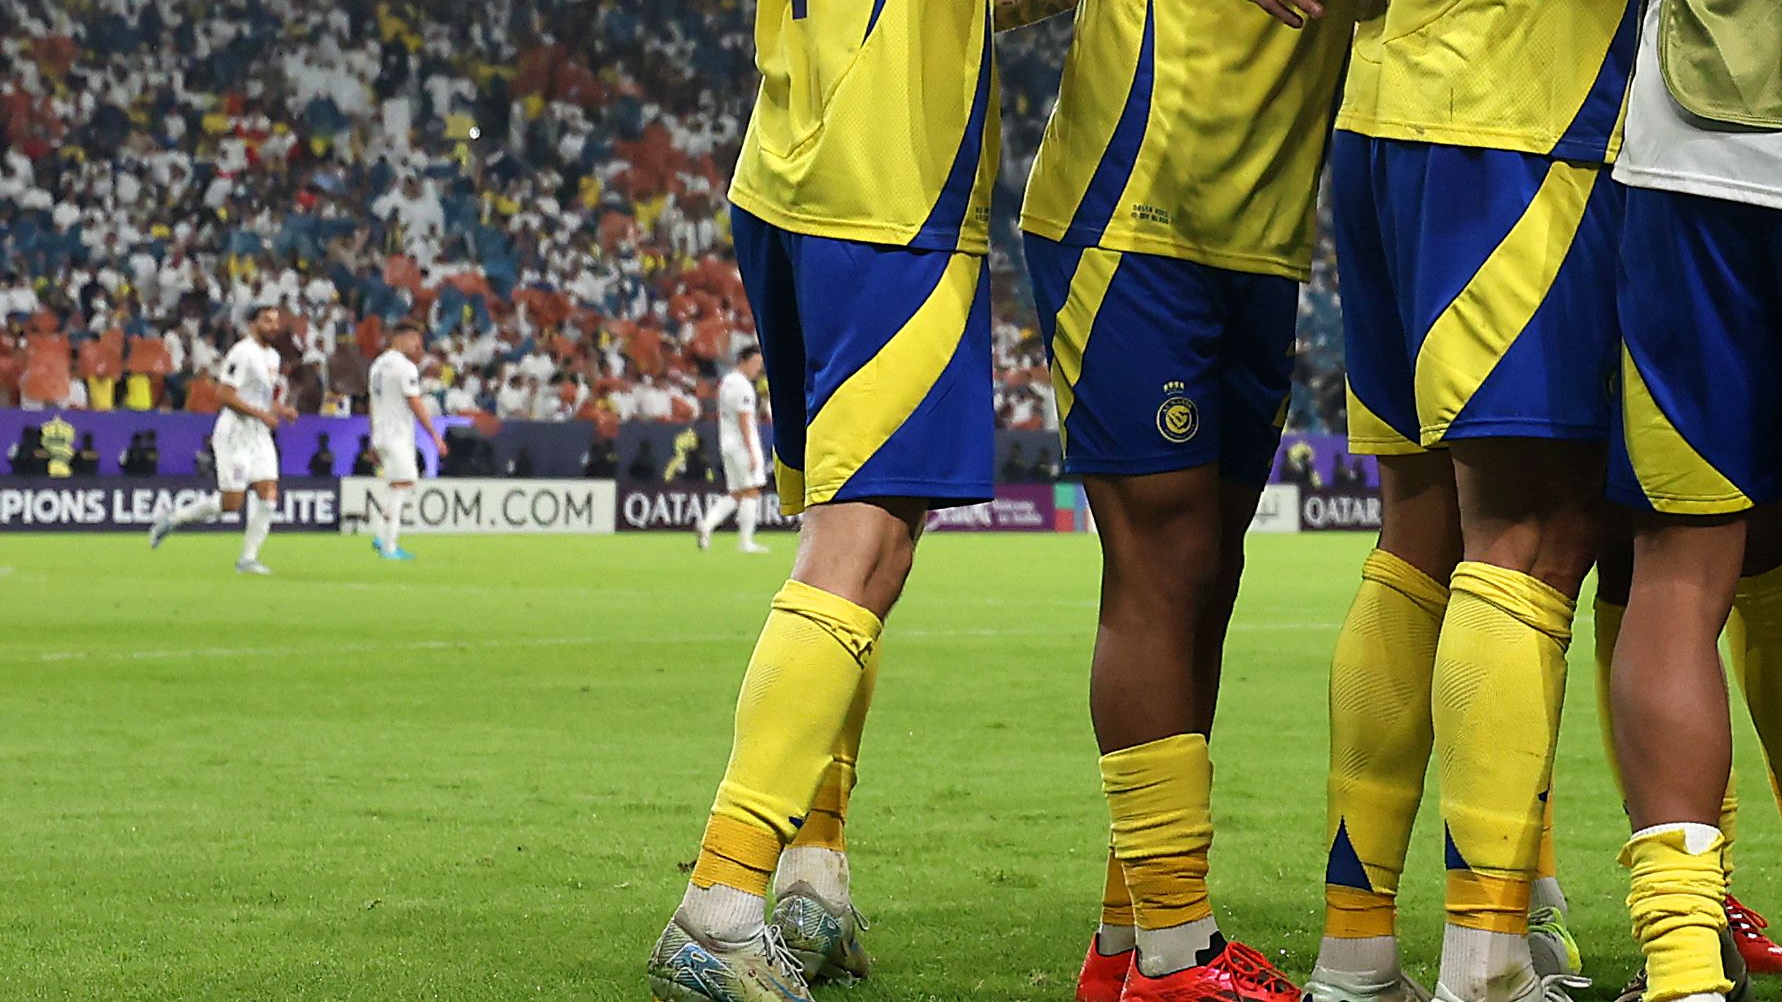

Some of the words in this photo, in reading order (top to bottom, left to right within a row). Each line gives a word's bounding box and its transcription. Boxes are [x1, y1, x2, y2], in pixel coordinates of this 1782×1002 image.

[0, 488, 105, 524] PIONS
[113, 488, 240, 524] LEA
[1304, 496, 1382, 529] QATAR
